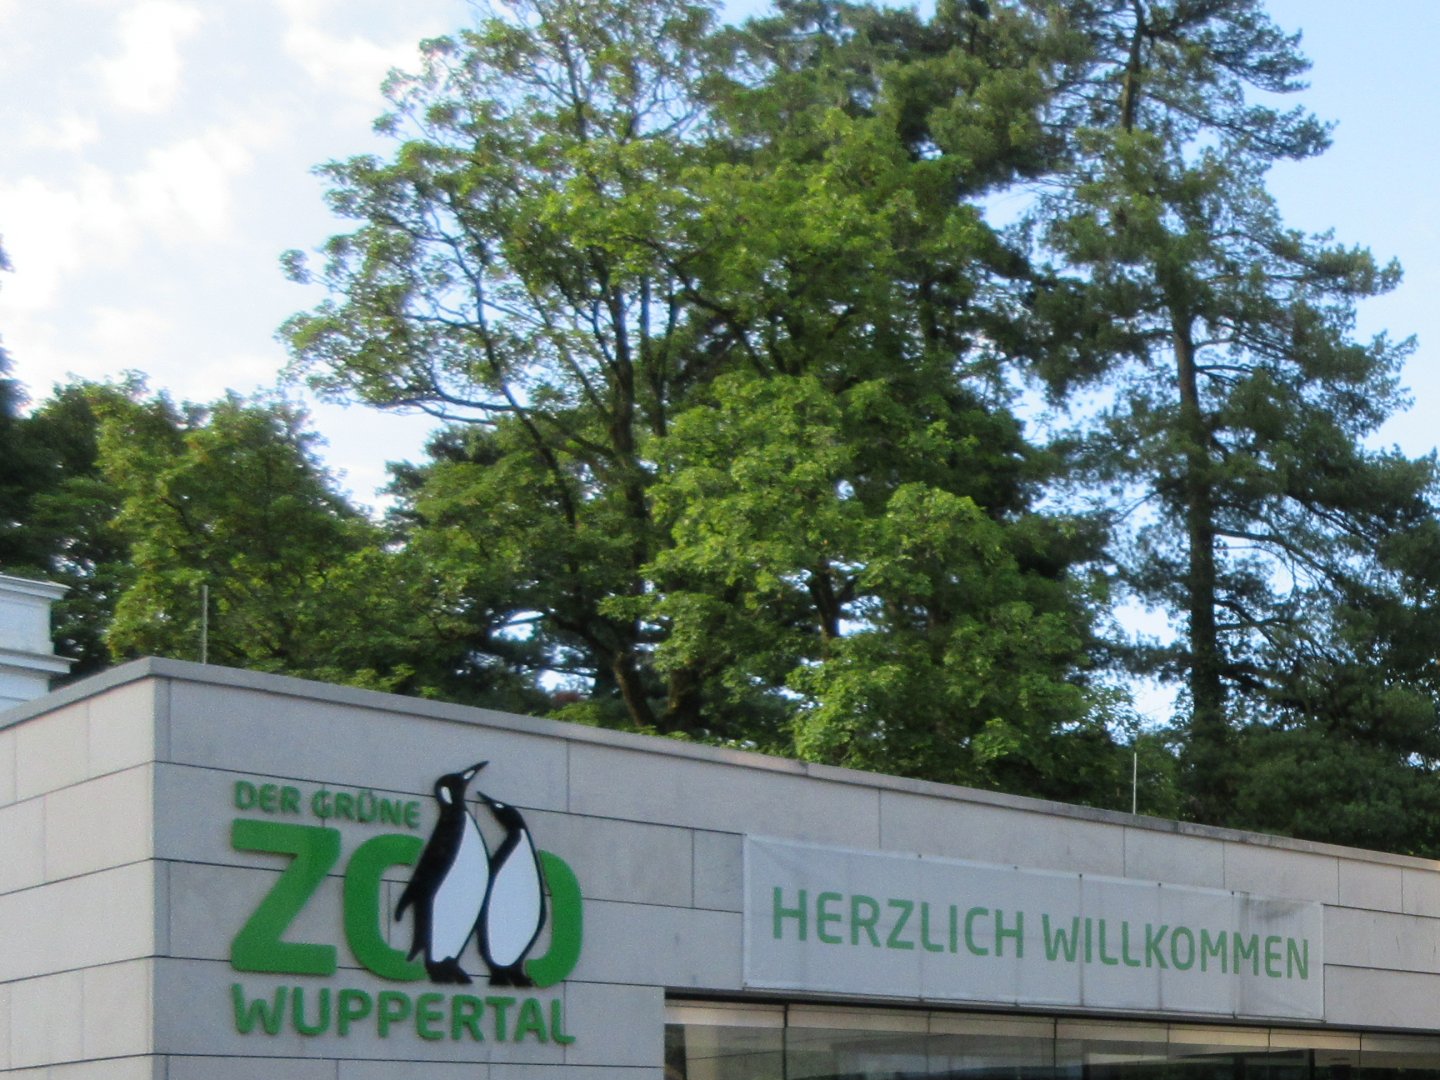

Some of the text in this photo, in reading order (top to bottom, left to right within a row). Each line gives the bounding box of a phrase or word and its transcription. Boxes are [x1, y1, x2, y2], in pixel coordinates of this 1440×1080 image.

[234, 780, 421, 828] DER GRÜNE
[772, 886, 1310, 980] HERZLICH WILLKOMMEN
[231, 982, 576, 1045] WUPPERTAL
